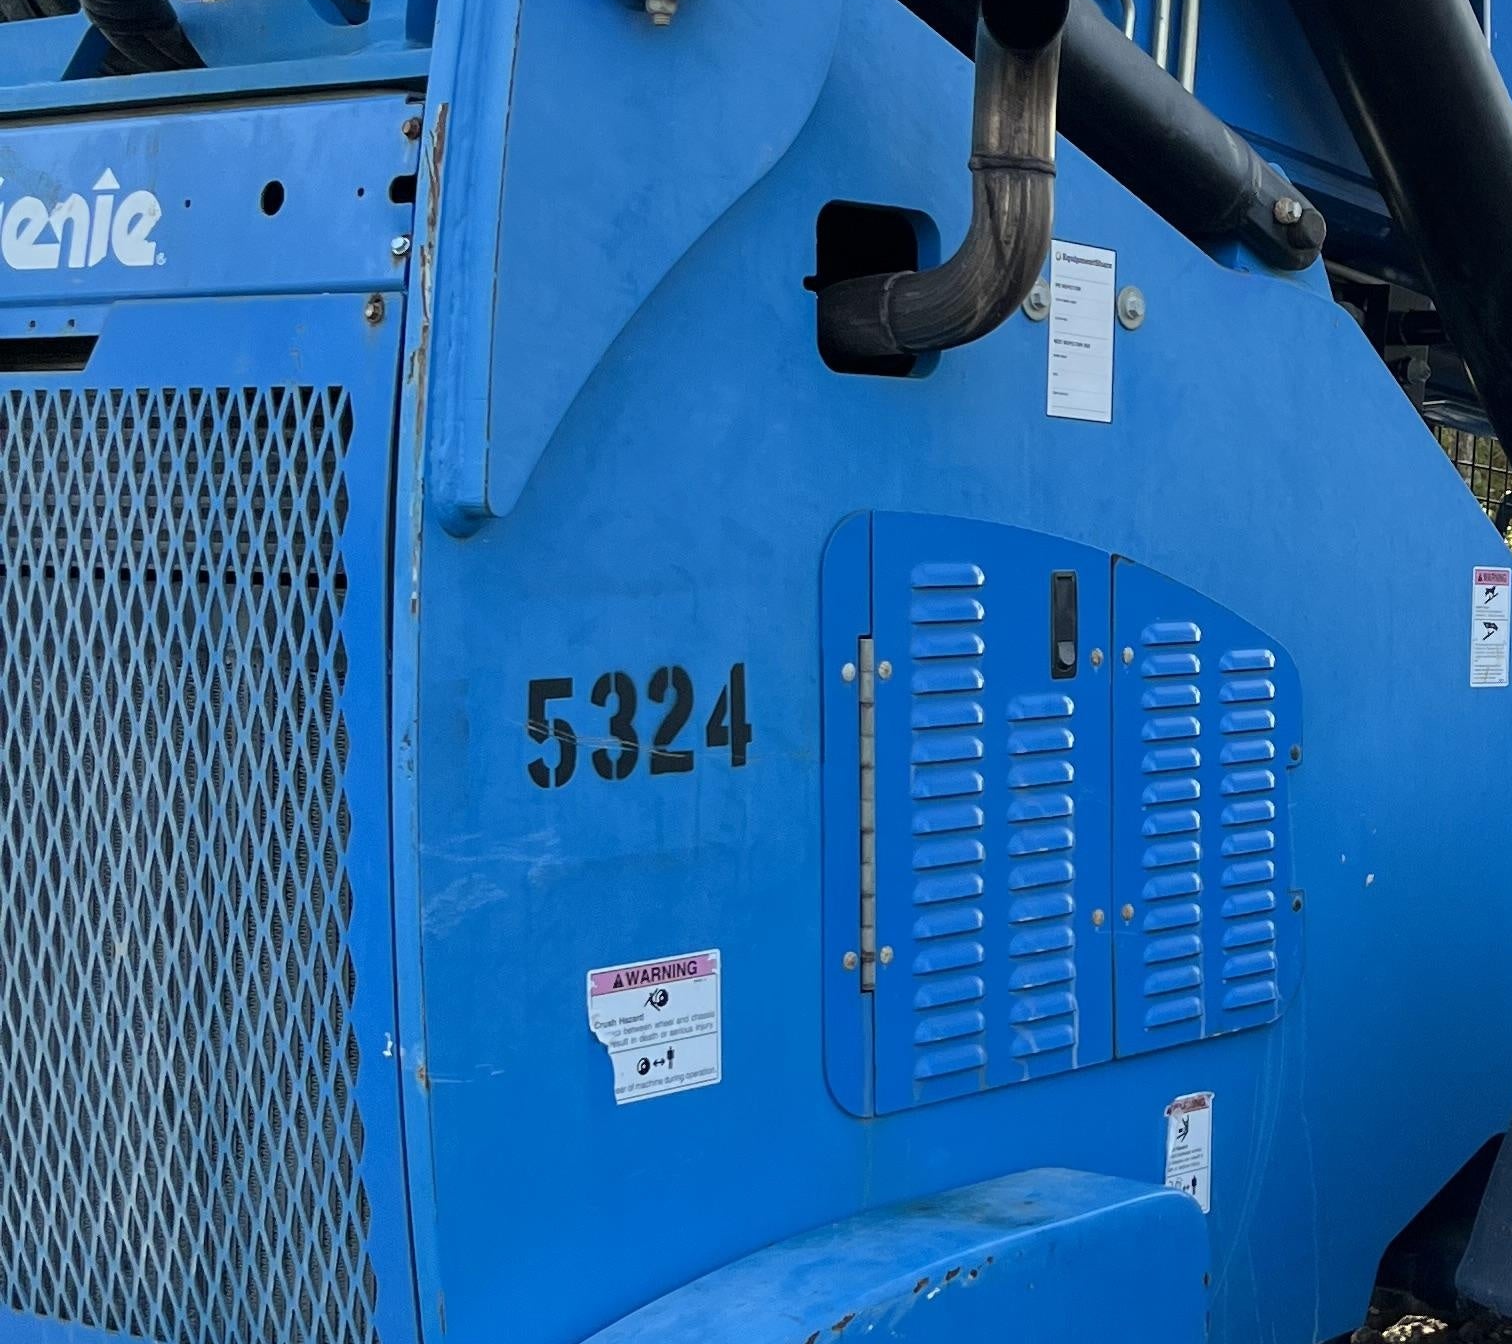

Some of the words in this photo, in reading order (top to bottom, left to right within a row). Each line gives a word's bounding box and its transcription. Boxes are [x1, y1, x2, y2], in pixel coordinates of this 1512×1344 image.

[0, 167, 162, 270] enie
[527, 662, 752, 788] 5324
[625, 960, 698, 986] WARNING
[618, 1013, 645, 1026] Hazard
